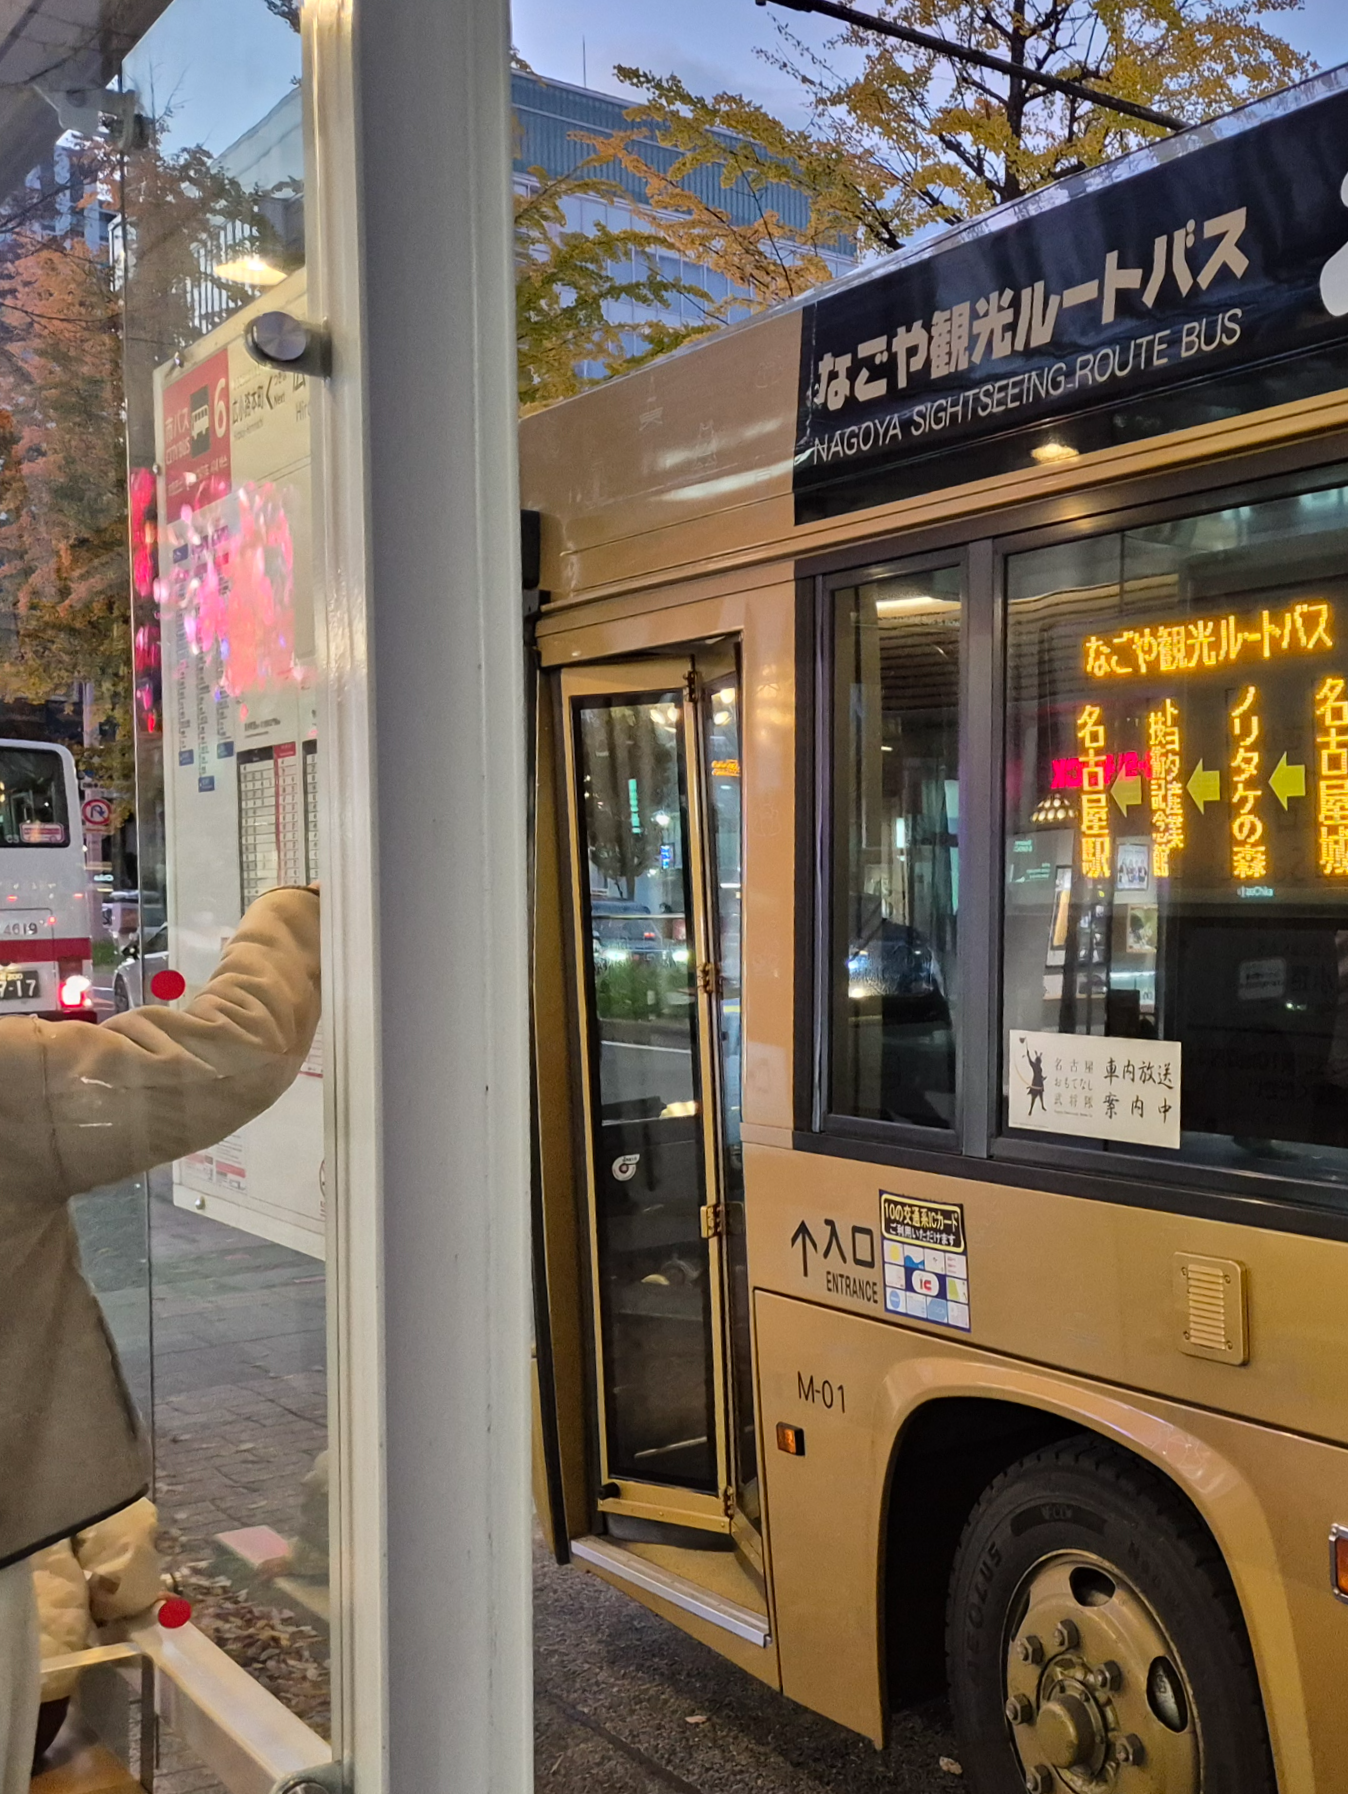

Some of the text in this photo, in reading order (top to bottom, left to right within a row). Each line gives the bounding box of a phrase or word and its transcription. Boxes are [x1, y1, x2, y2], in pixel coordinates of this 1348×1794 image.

[814, 206, 1250, 411] なごや観光ルートバス
[214, 377, 227, 438] 6
[813, 308, 1244, 465] NAGOYA SIGHTSEEING ROUTE BUS
[1084, 602, 1333, 677] なごや観光ルートバス
[1077, 704, 1111, 878] 名古屋駅
[1231, 685, 1267, 879] ノリタケの森
[1054, 1057, 1094, 1074] 名古屋
[1054, 1077, 1093, 1091] おもてなし
[1103, 1056, 1174, 1090] 車内放送
[1103, 1091, 1172, 1124] 案内中
[884, 1202, 959, 1232] 10の交通系ICカード
[889, 1223, 956, 1246] ご利用いただけます
[822, 1218, 875, 1269] 入口
[826, 1270, 879, 1305] ENTRANCE
[797, 1370, 846, 1414] M-01
